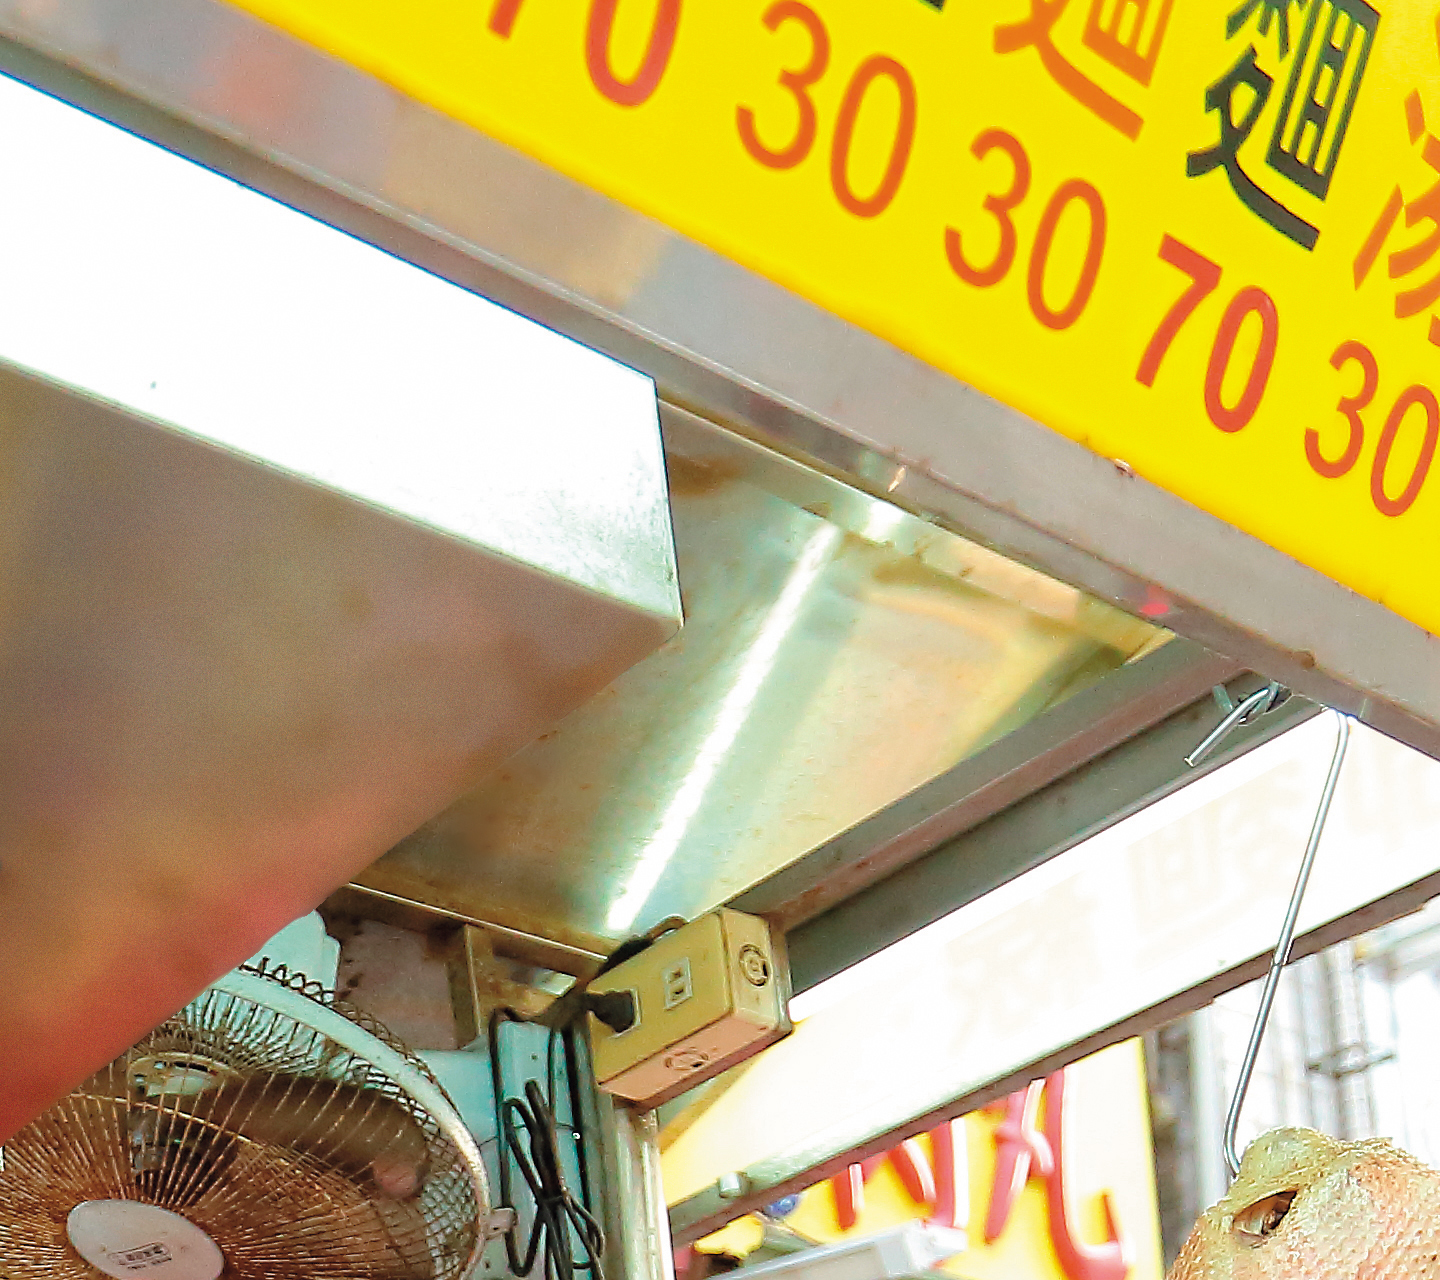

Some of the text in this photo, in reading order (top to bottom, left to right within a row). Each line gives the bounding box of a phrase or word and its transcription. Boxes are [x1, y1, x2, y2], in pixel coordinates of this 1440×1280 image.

[736, 0, 917, 218] 30
[944, 127, 1108, 332] 30
[1134, 233, 1280, 434] 70
[1304, 340, 1440, 517] 30
